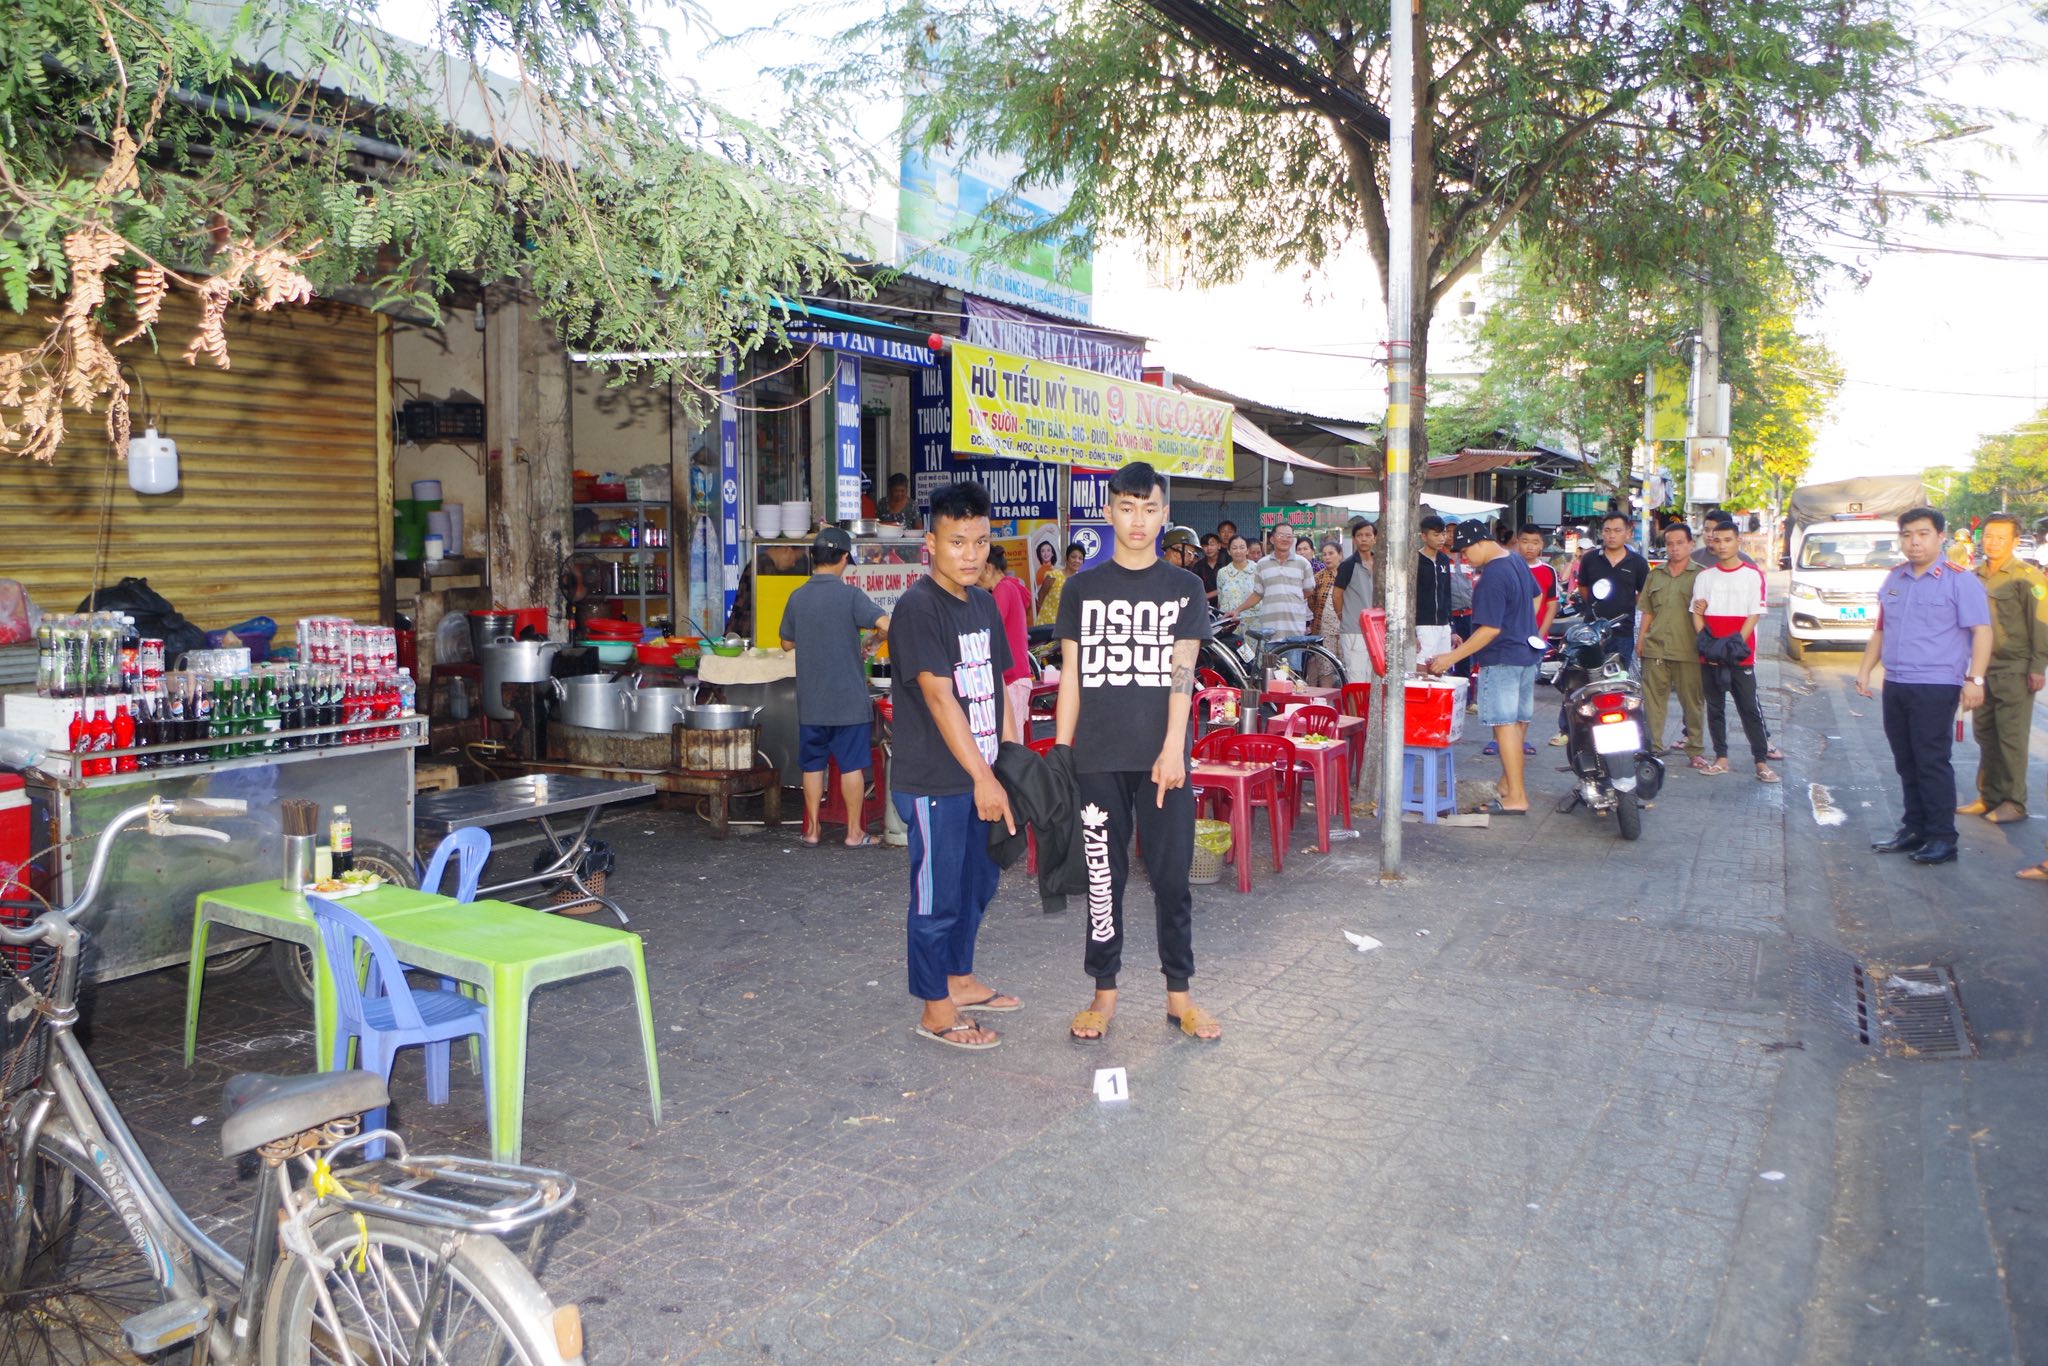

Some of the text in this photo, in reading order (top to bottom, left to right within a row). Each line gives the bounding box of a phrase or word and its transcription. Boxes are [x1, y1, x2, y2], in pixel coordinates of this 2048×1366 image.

[1060, 329, 1092, 370] VÂN
[841, 358, 856, 387] NHÀ
[922, 366, 944, 396] NHÀ
[838, 395, 860, 428] THUỐC
[971, 357, 997, 398] HỦ
[1002, 365, 1040, 406] TIẾU
[1045, 376, 1067, 411] MỸ
[1106, 385, 1126, 426] 9
[1135, 391, 1223, 442] NGOAN
[918, 400, 951, 434] THUỐC
[969, 408, 988, 427] TT
[1026, 418, 1045, 440] THỊT
[843, 440, 856, 468] TÂY
[924, 440, 944, 471] TÂY
[1017, 441, 1033, 454] HỌC
[1060, 445, 1069, 455] MỸ
[982, 461, 1028, 503] THUỐC
[1031, 462, 1056, 502] TÂY
[1073, 474, 1097, 508] NHÀ
[994, 506, 1040, 518] TRANG
[1261, 512, 1276, 526] SINH
[866, 570, 884, 592] BÁNH
[885, 574, 902, 590] CANH
[1081, 599, 1180, 645] DSQ2
[1083, 829, 1115, 942] DSQUARED2
[1107, 1073, 1118, 1095] 1
[100, 1162, 141, 1224] OSAKA
